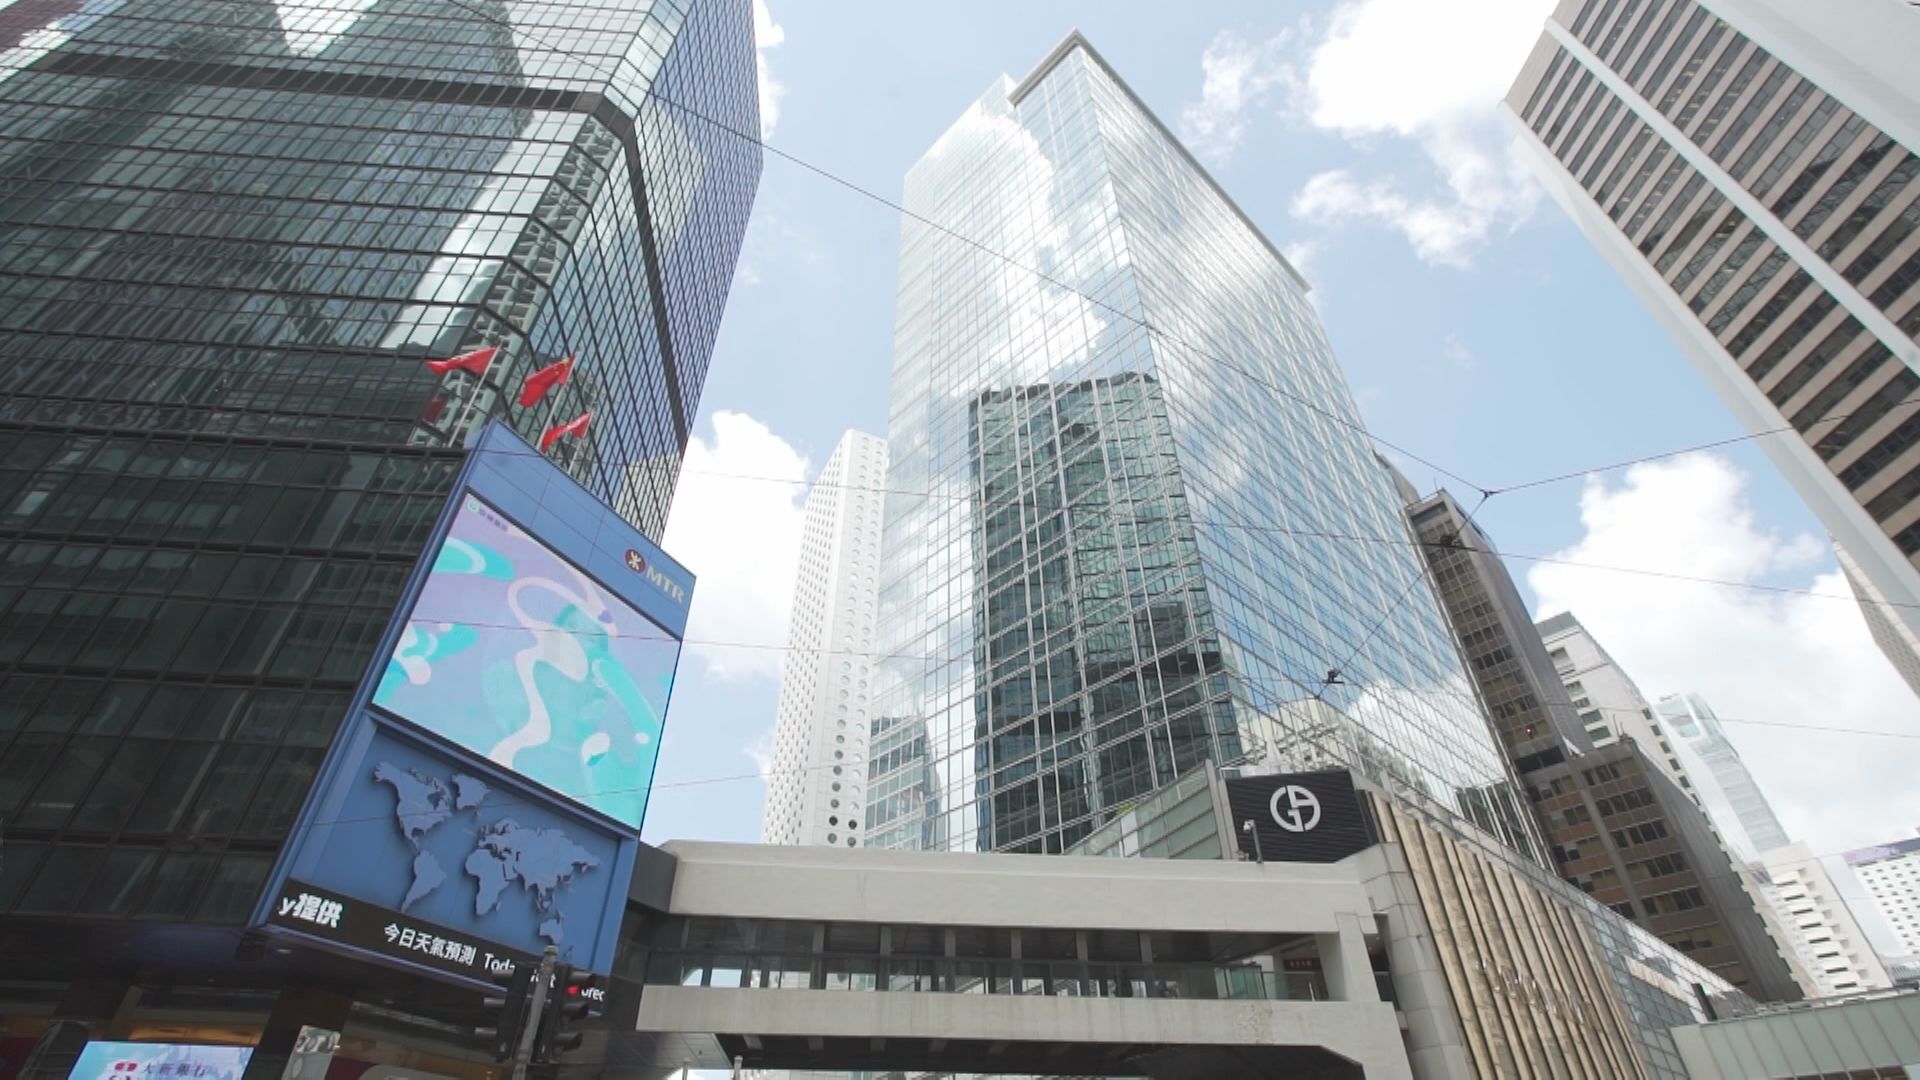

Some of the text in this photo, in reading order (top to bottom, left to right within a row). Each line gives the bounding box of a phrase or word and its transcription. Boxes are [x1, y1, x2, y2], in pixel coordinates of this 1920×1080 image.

[646, 565, 684, 603] MTR
[384, 923, 477, 966] 今日天氣預測
